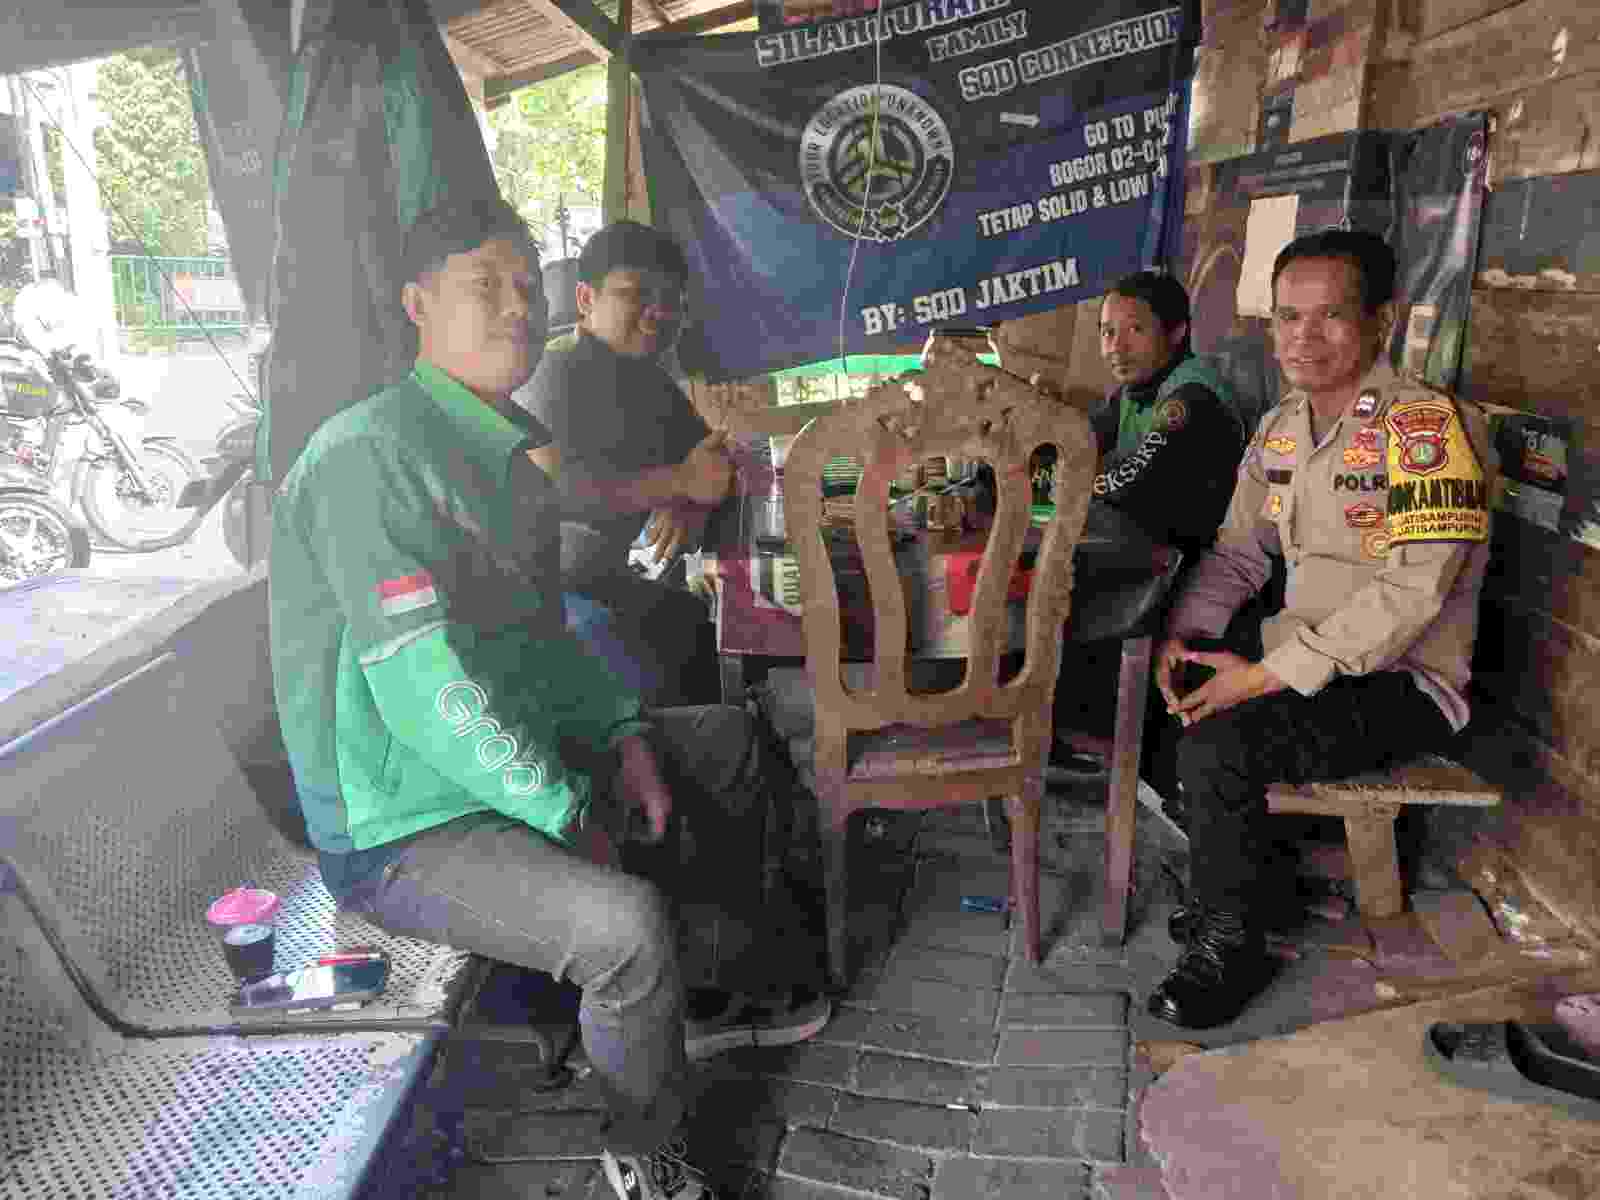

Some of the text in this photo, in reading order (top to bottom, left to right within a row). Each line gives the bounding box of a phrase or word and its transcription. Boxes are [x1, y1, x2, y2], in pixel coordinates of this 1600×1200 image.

[926, 9, 1027, 62] FAMILY
[958, 57, 1018, 101] SQD
[1083, 121, 1109, 148] GO
[1111, 113, 1136, 141] TO
[1050, 151, 1109, 188] BOGOR
[977, 203, 1035, 238] TETAP
[1038, 189, 1089, 223] SOLID
[1092, 184, 1108, 209] &
[1109, 172, 1150, 204] LOW
[862, 257, 1080, 336] BY: SQD JAKTIM
[434, 679, 544, 800] Grab
